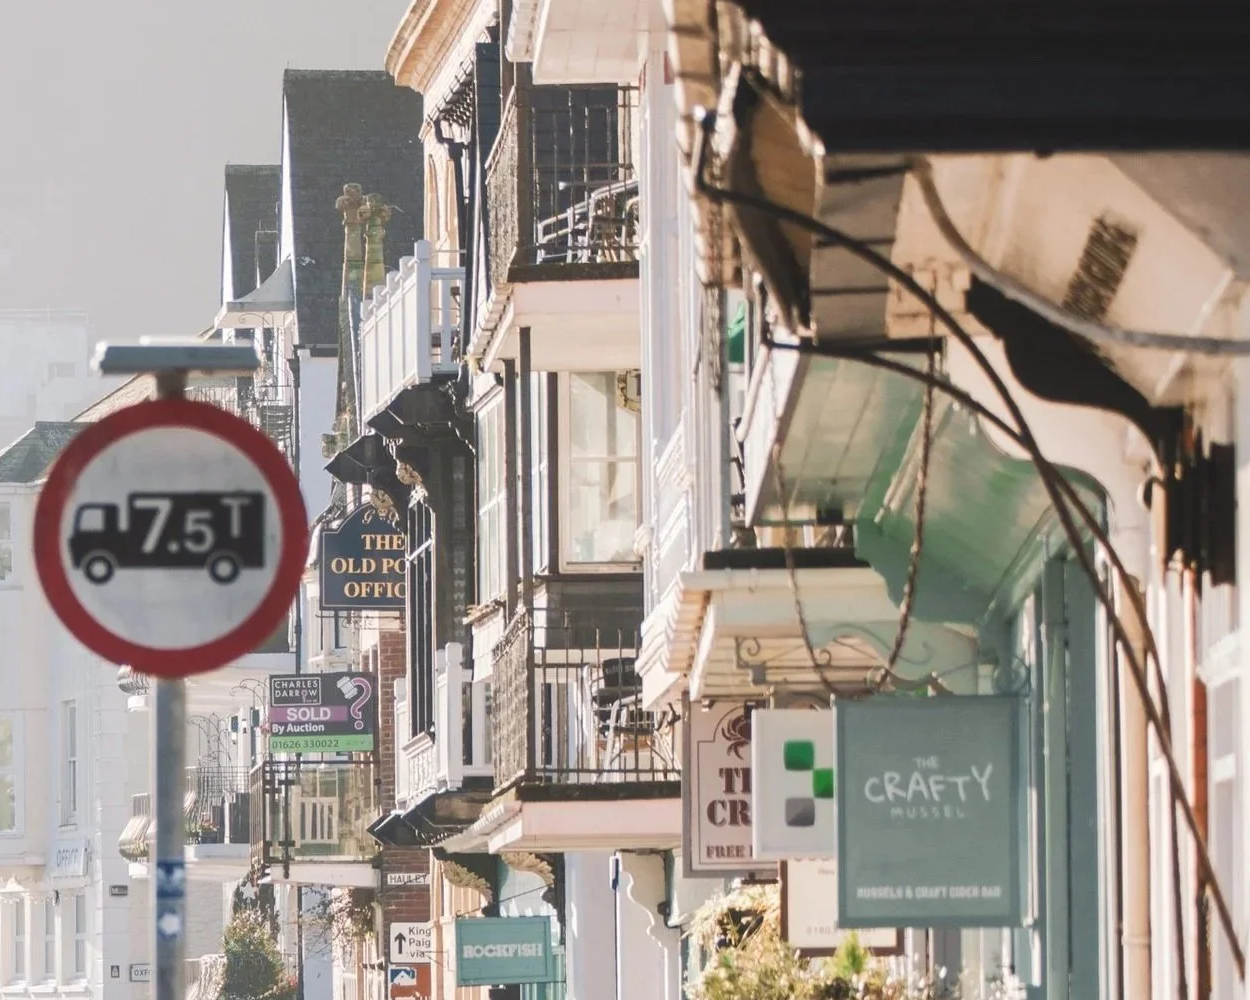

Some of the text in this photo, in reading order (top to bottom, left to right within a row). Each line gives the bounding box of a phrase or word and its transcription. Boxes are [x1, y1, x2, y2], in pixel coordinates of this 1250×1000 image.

[361, 533, 406, 551] THE
[330, 557, 377, 574] OLD
[274, 680, 318, 689] CHARLES
[274, 689, 318, 698] DARROW
[286, 707, 331, 721] SOLD
[271, 722, 325, 735] By Auction
[272, 741, 301, 749] 01626
[303, 739, 340, 749] 330022
[912, 755, 939, 769] THE
[864, 762, 993, 803] CRAFTY
[890, 804, 965, 819] MUSSEL
[706, 845, 746, 859] FREE
[463, 943, 543, 959] ROCKFISH
